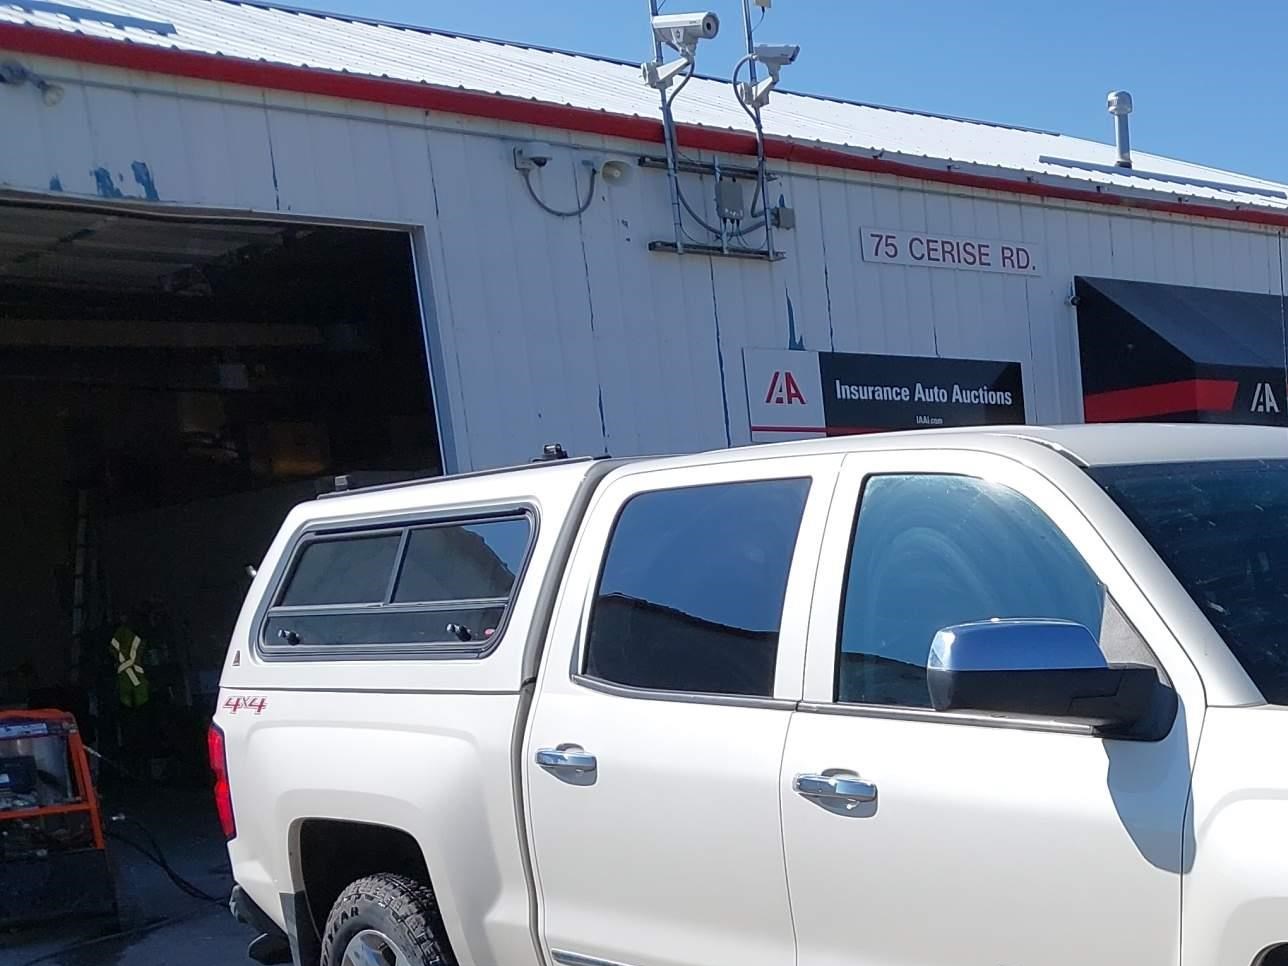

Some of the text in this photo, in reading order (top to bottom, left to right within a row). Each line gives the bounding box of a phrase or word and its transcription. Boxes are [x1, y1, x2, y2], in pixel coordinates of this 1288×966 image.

[869, 233, 1036, 271] 75 CERISE RD.
[834, 379, 1013, 406] Insurance Auto Auctions
